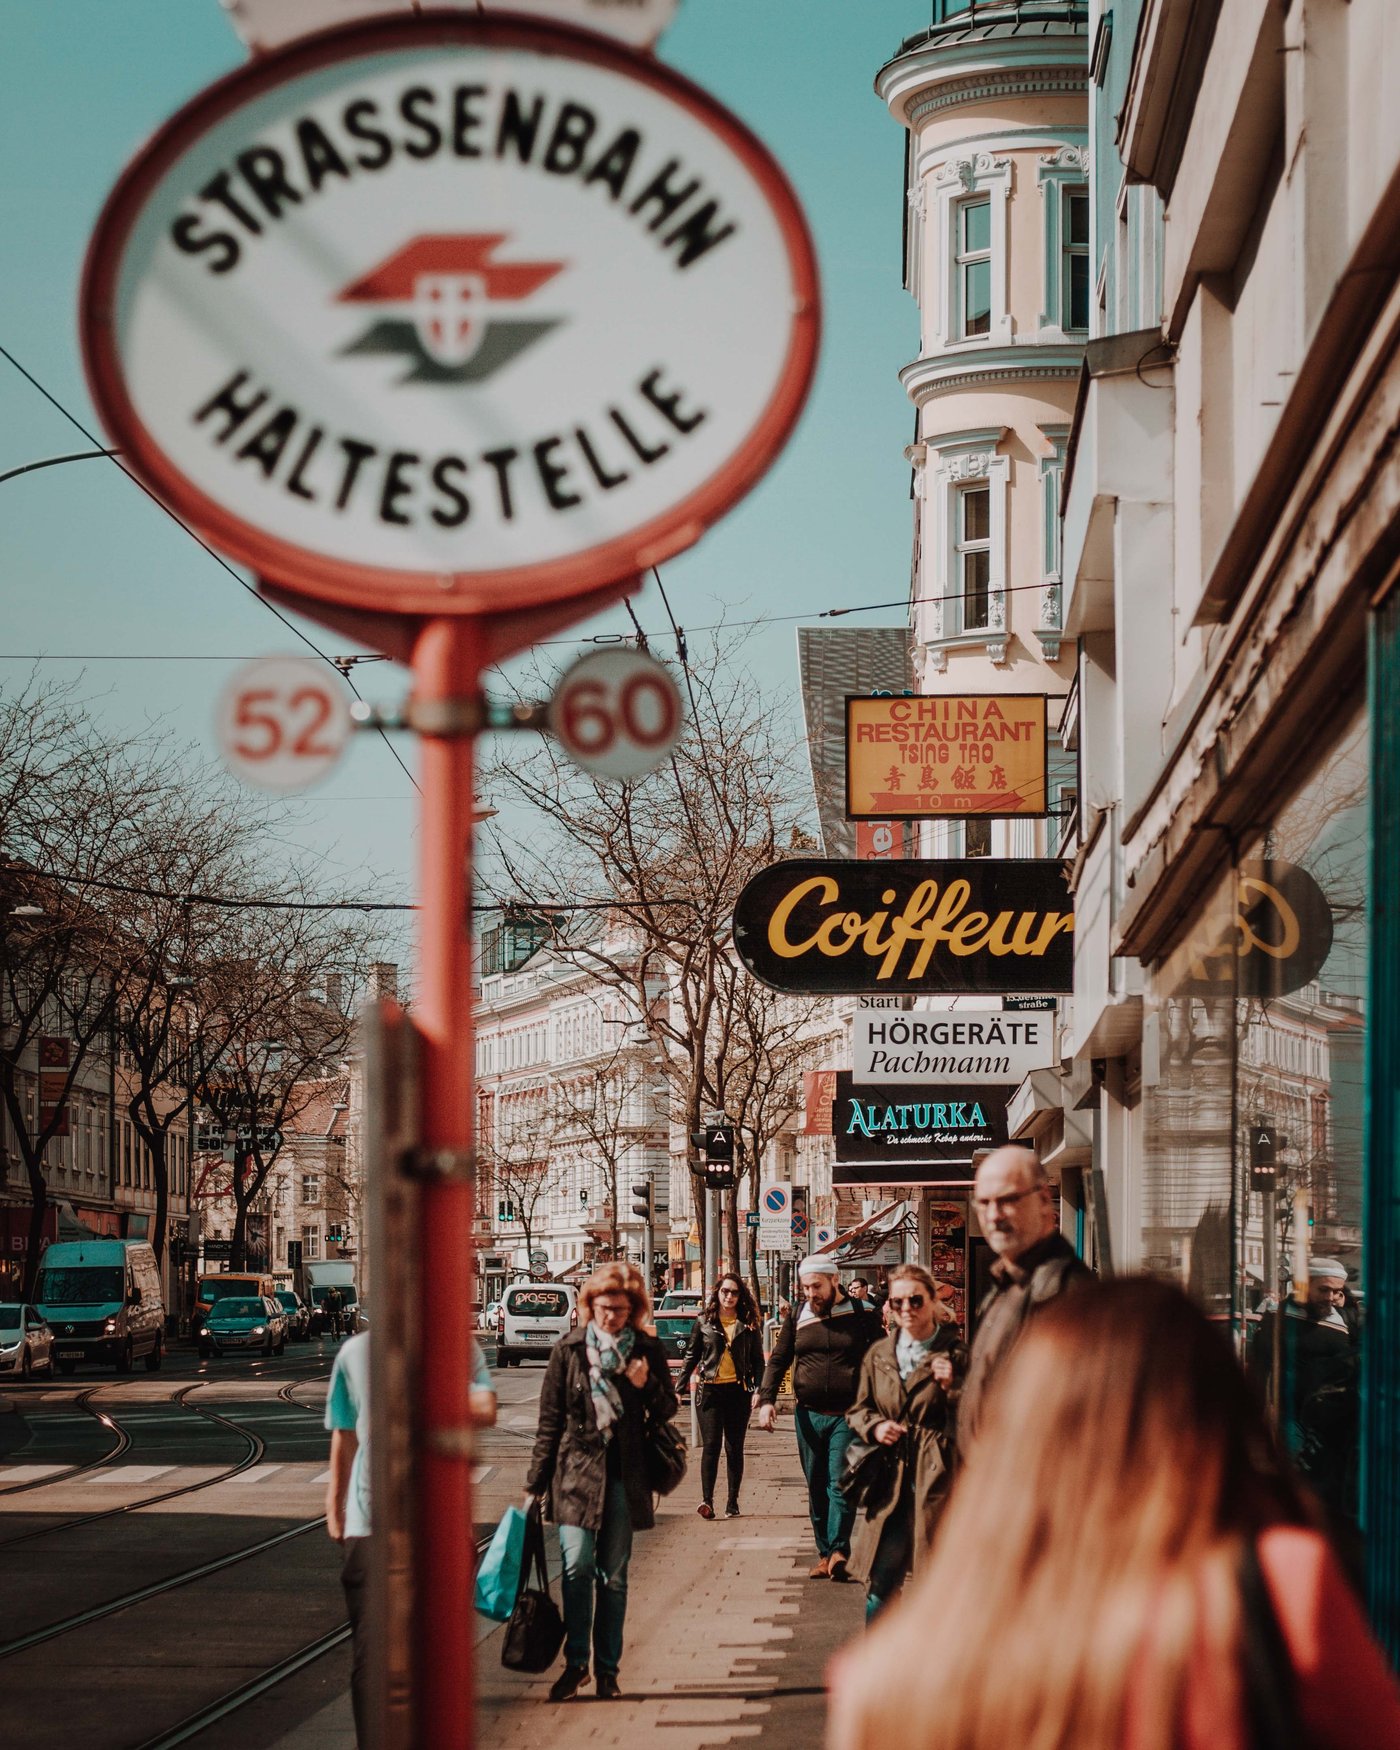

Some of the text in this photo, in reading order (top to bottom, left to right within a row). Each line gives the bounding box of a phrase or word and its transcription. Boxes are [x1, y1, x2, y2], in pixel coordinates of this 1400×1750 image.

[171, 85, 738, 274] STRASSENBAHN
[193, 367, 708, 529] HALTESTELLE
[560, 673, 674, 758] 60
[889, 700, 1004, 722] CHINA
[232, 687, 336, 763] 52
[856, 721, 1037, 743] RESTAURANT
[959, 743, 994, 764] TAO
[914, 796, 972, 808] 10 m
[768, 876, 1075, 980] Coiffeur
[1018, 999, 1049, 1010] straße
[868, 1017, 1038, 1045] HÖRGERÄTE
[867, 1050, 1011, 1074] Pachmann
[846, 1098, 987, 1138] ALATURKA
[712, 1131, 727, 1143] A
[886, 1134, 899, 1145] Da
[900, 1134, 932, 1144] schmeckt
[933, 1132, 958, 1145] Kebap
[11, 1236, 52, 1251] BIA
